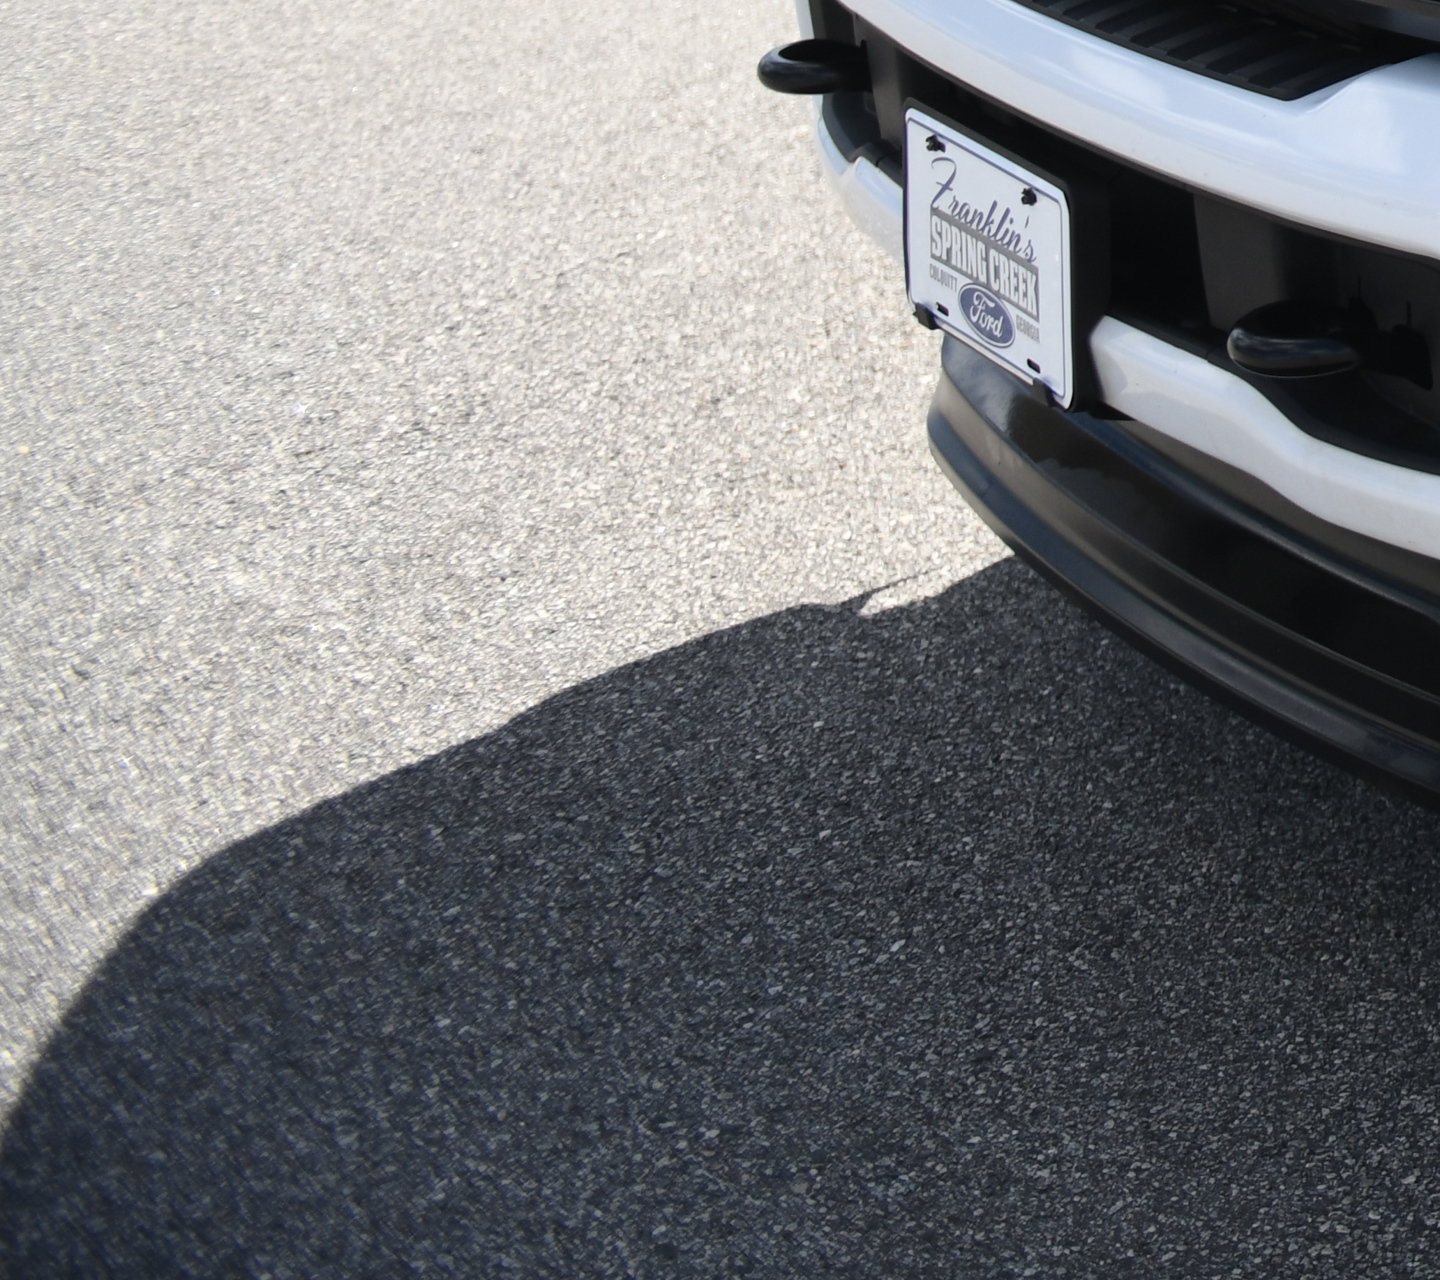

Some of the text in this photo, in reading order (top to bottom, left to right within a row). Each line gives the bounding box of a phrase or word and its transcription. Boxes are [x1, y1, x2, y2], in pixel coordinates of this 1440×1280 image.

[930, 156, 1038, 264] Franklin's
[930, 213, 1039, 318] SPRING CREEK
[969, 291, 1005, 339] Ford
